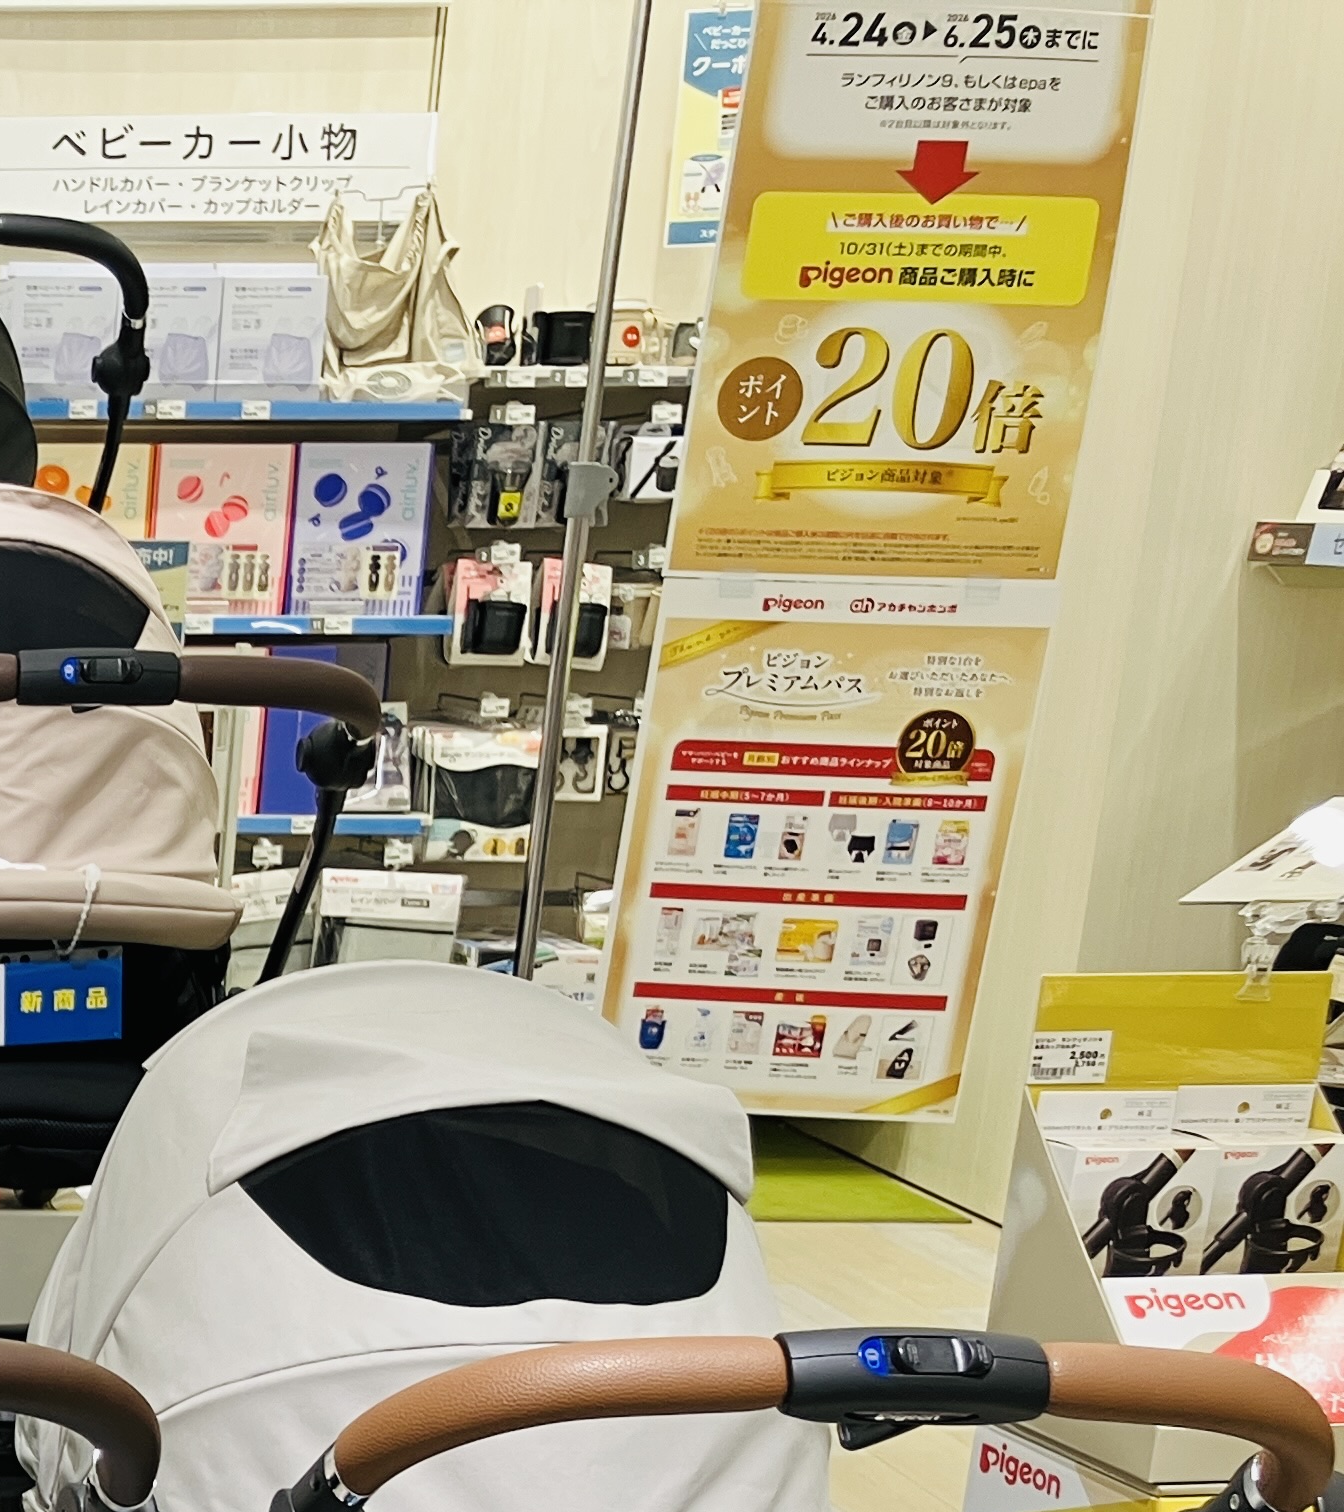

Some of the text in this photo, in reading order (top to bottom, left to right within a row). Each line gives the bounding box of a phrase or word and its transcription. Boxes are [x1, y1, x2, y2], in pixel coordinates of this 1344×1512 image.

[864, 95, 1033, 114] ご購入のお客さまが対象
[52, 123, 358, 161] ベビーカー小物
[798, 264, 1035, 289] pigeon 商品ご購入時に
[762, 596, 825, 613] pigeon
[722, 667, 863, 695] プレミアムパス
[1123, 1287, 1247, 1320] pigeon
[979, 1442, 1062, 1500] pigeon
